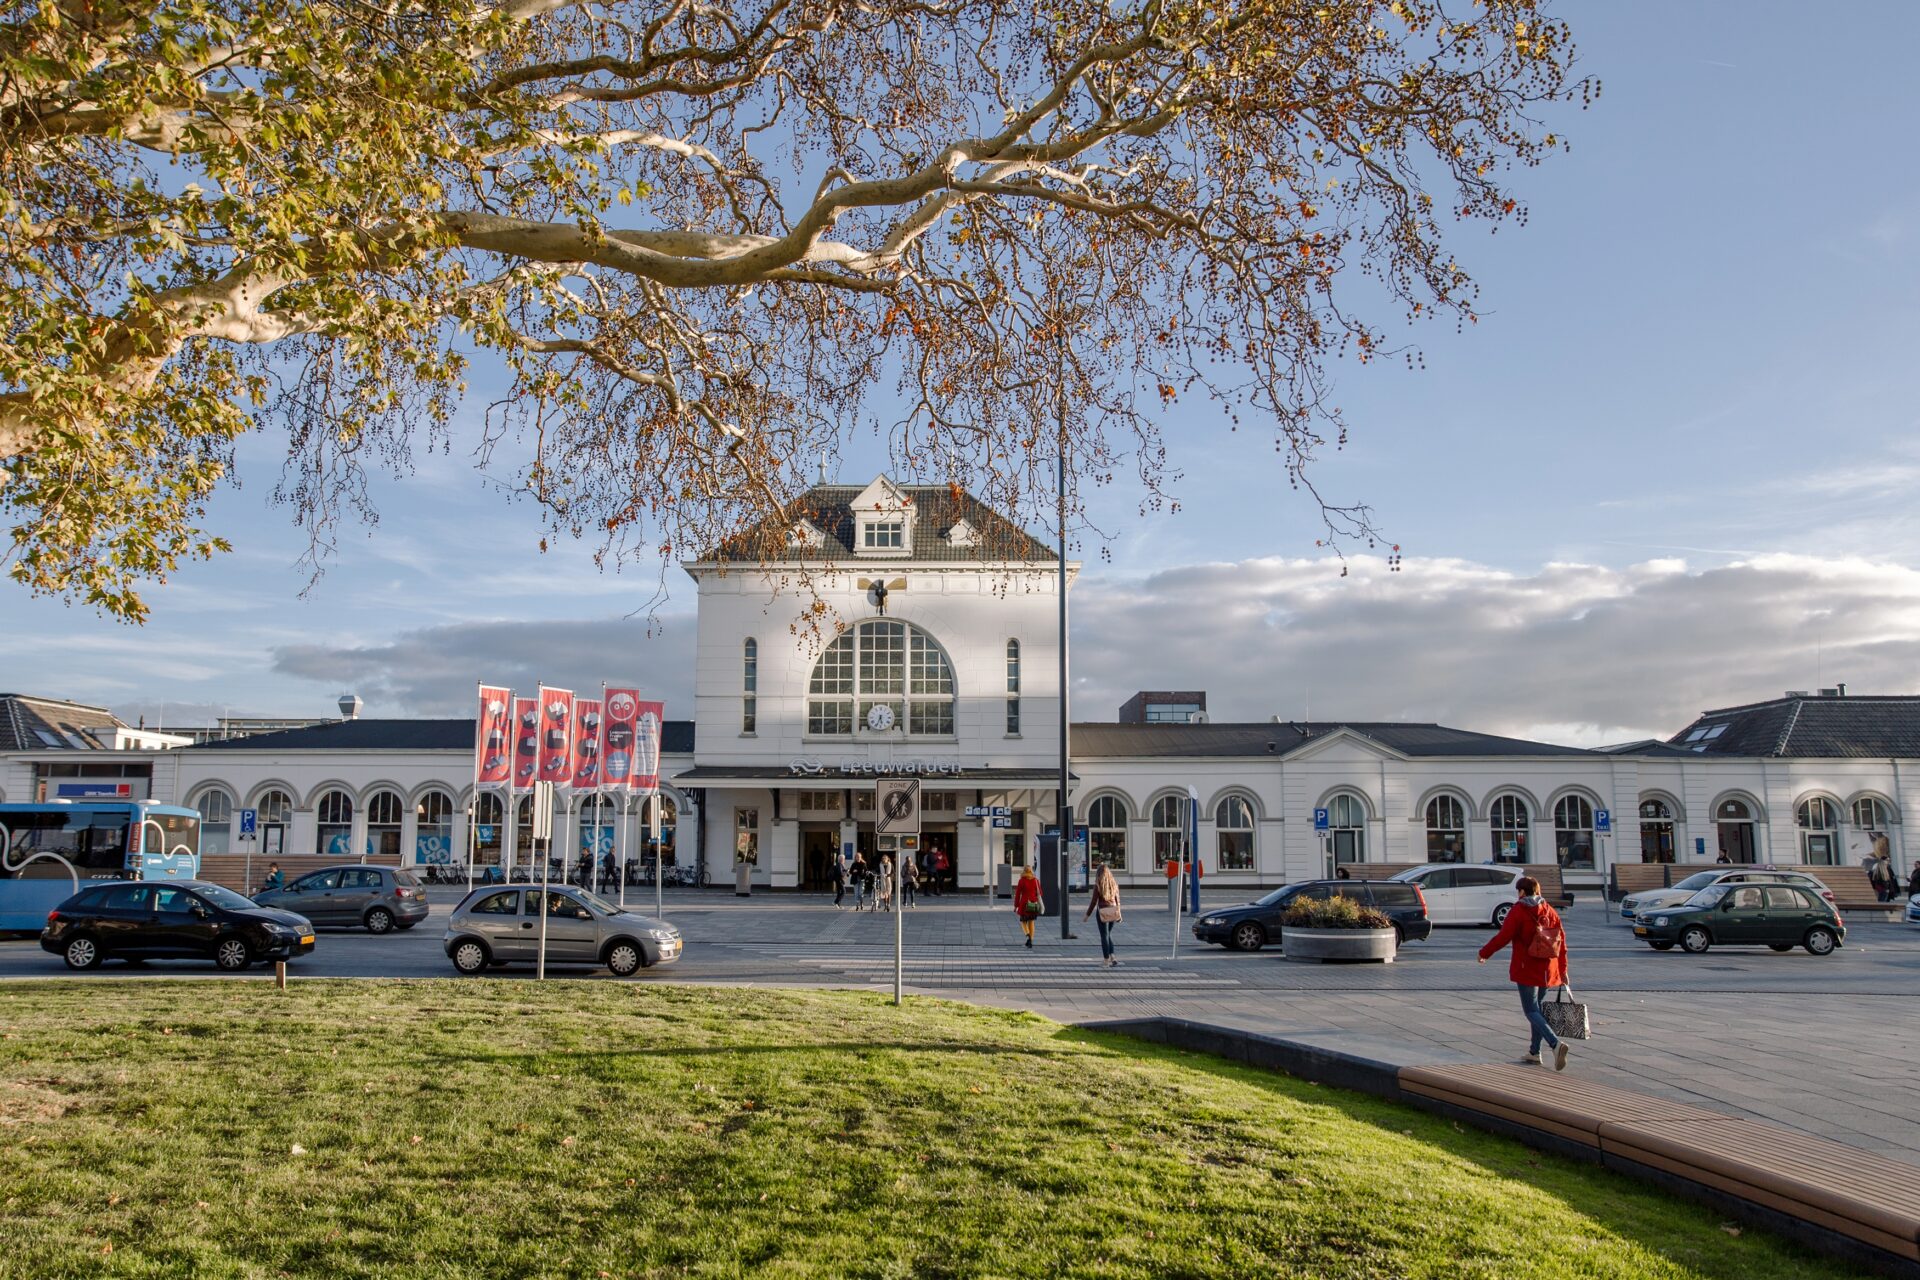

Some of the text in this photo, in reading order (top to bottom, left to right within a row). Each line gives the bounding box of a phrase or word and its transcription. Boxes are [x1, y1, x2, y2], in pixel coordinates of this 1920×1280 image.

[840, 758, 962, 773] Leeuwarden
[244, 811, 253, 823] P
[1317, 810, 1326, 822] P
[1598, 811, 1607, 823] P
[418, 836, 441, 855] to
